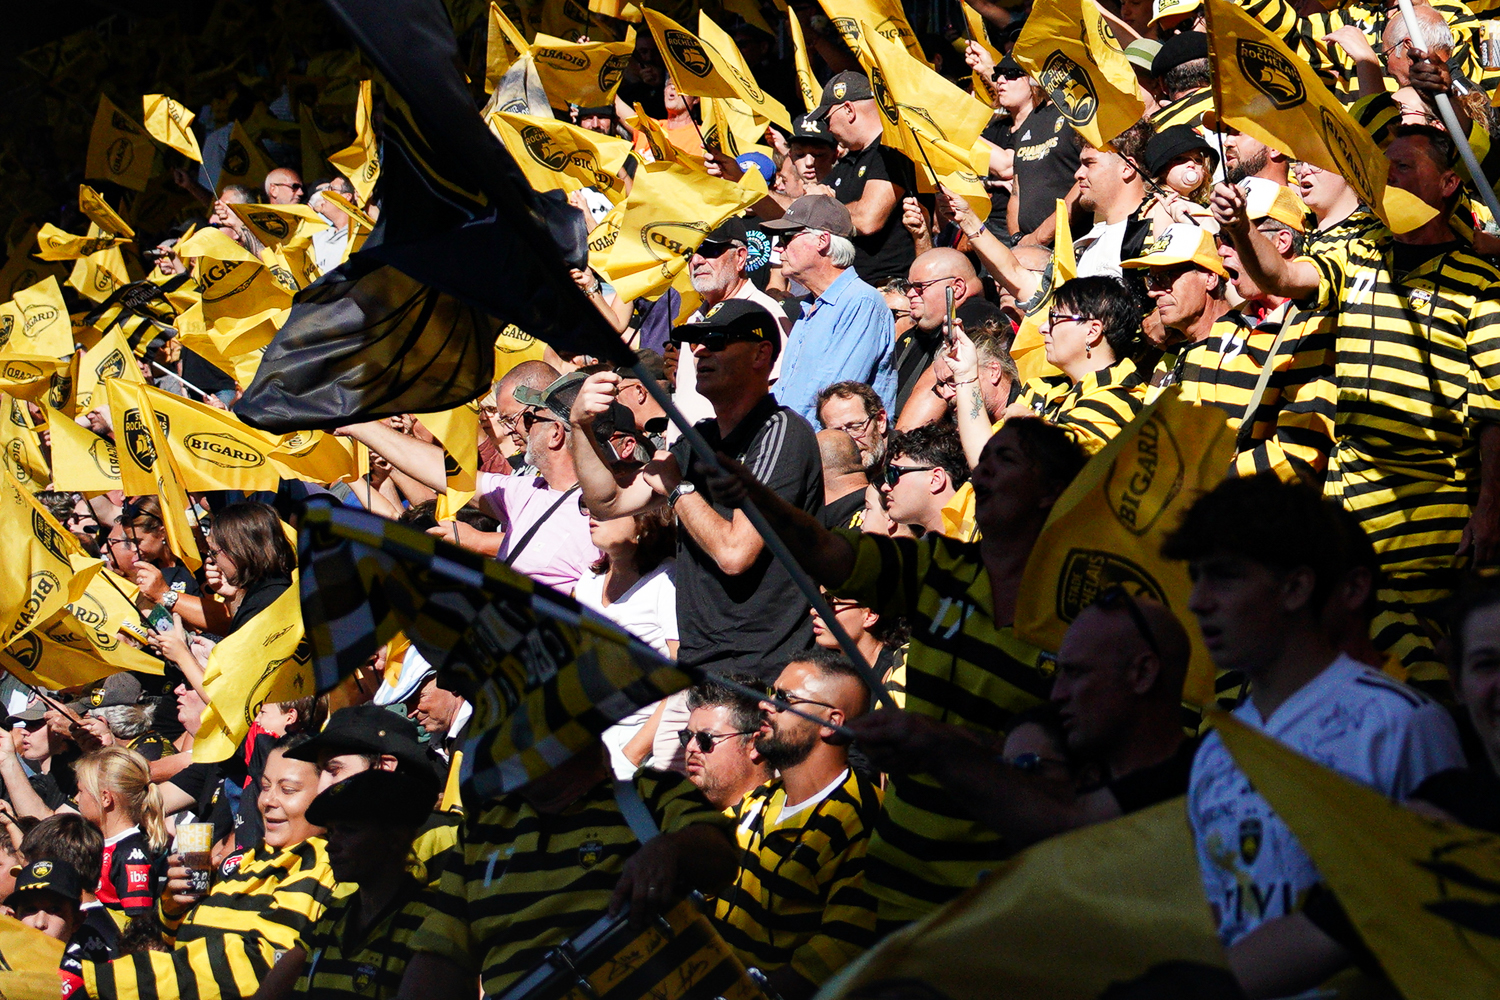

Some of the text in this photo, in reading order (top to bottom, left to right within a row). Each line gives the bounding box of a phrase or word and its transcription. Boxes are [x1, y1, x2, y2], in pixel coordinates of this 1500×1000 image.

[200, 260, 244, 294] BIGA
[190, 438, 259, 463] BIGARD
[1120, 419, 1160, 527] BIGARD
[64, 602, 100, 626] ARD
[129, 870, 149, 884] ibis
